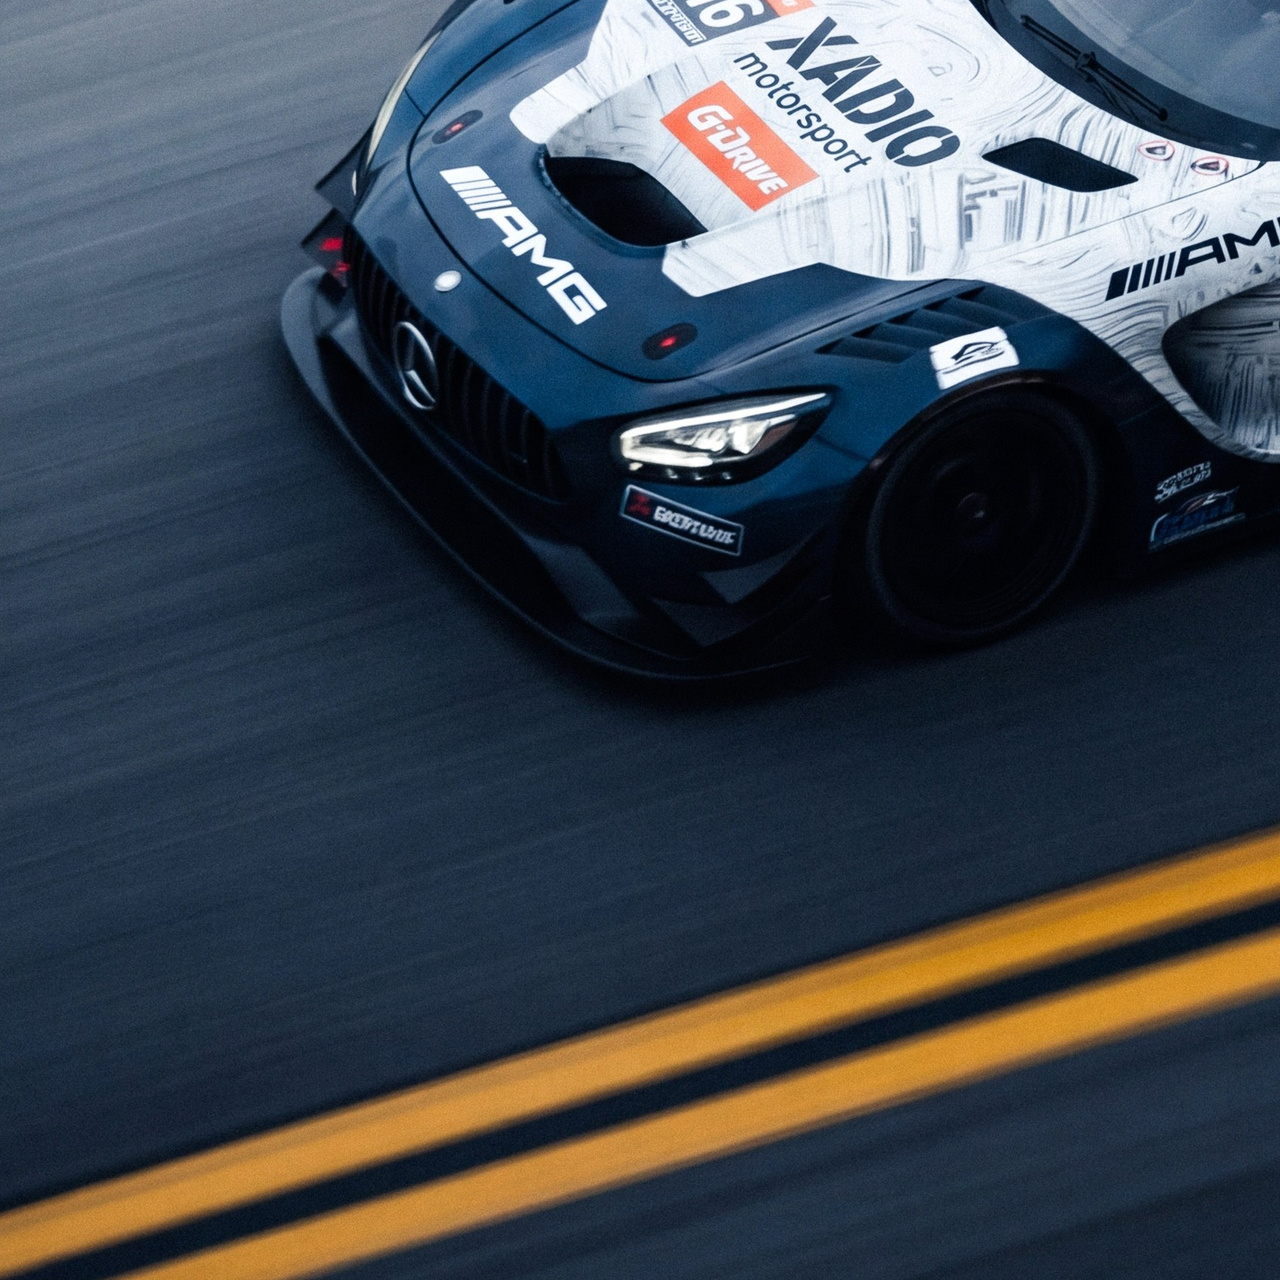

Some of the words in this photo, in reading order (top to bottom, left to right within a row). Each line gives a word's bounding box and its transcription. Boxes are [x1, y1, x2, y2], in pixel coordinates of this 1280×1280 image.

[687, 104, 789, 196] G-DRIVE
[733, 52, 872, 173] motorsport
[765, 16, 960, 167] XADIO
[476, 210, 607, 325] AMG
